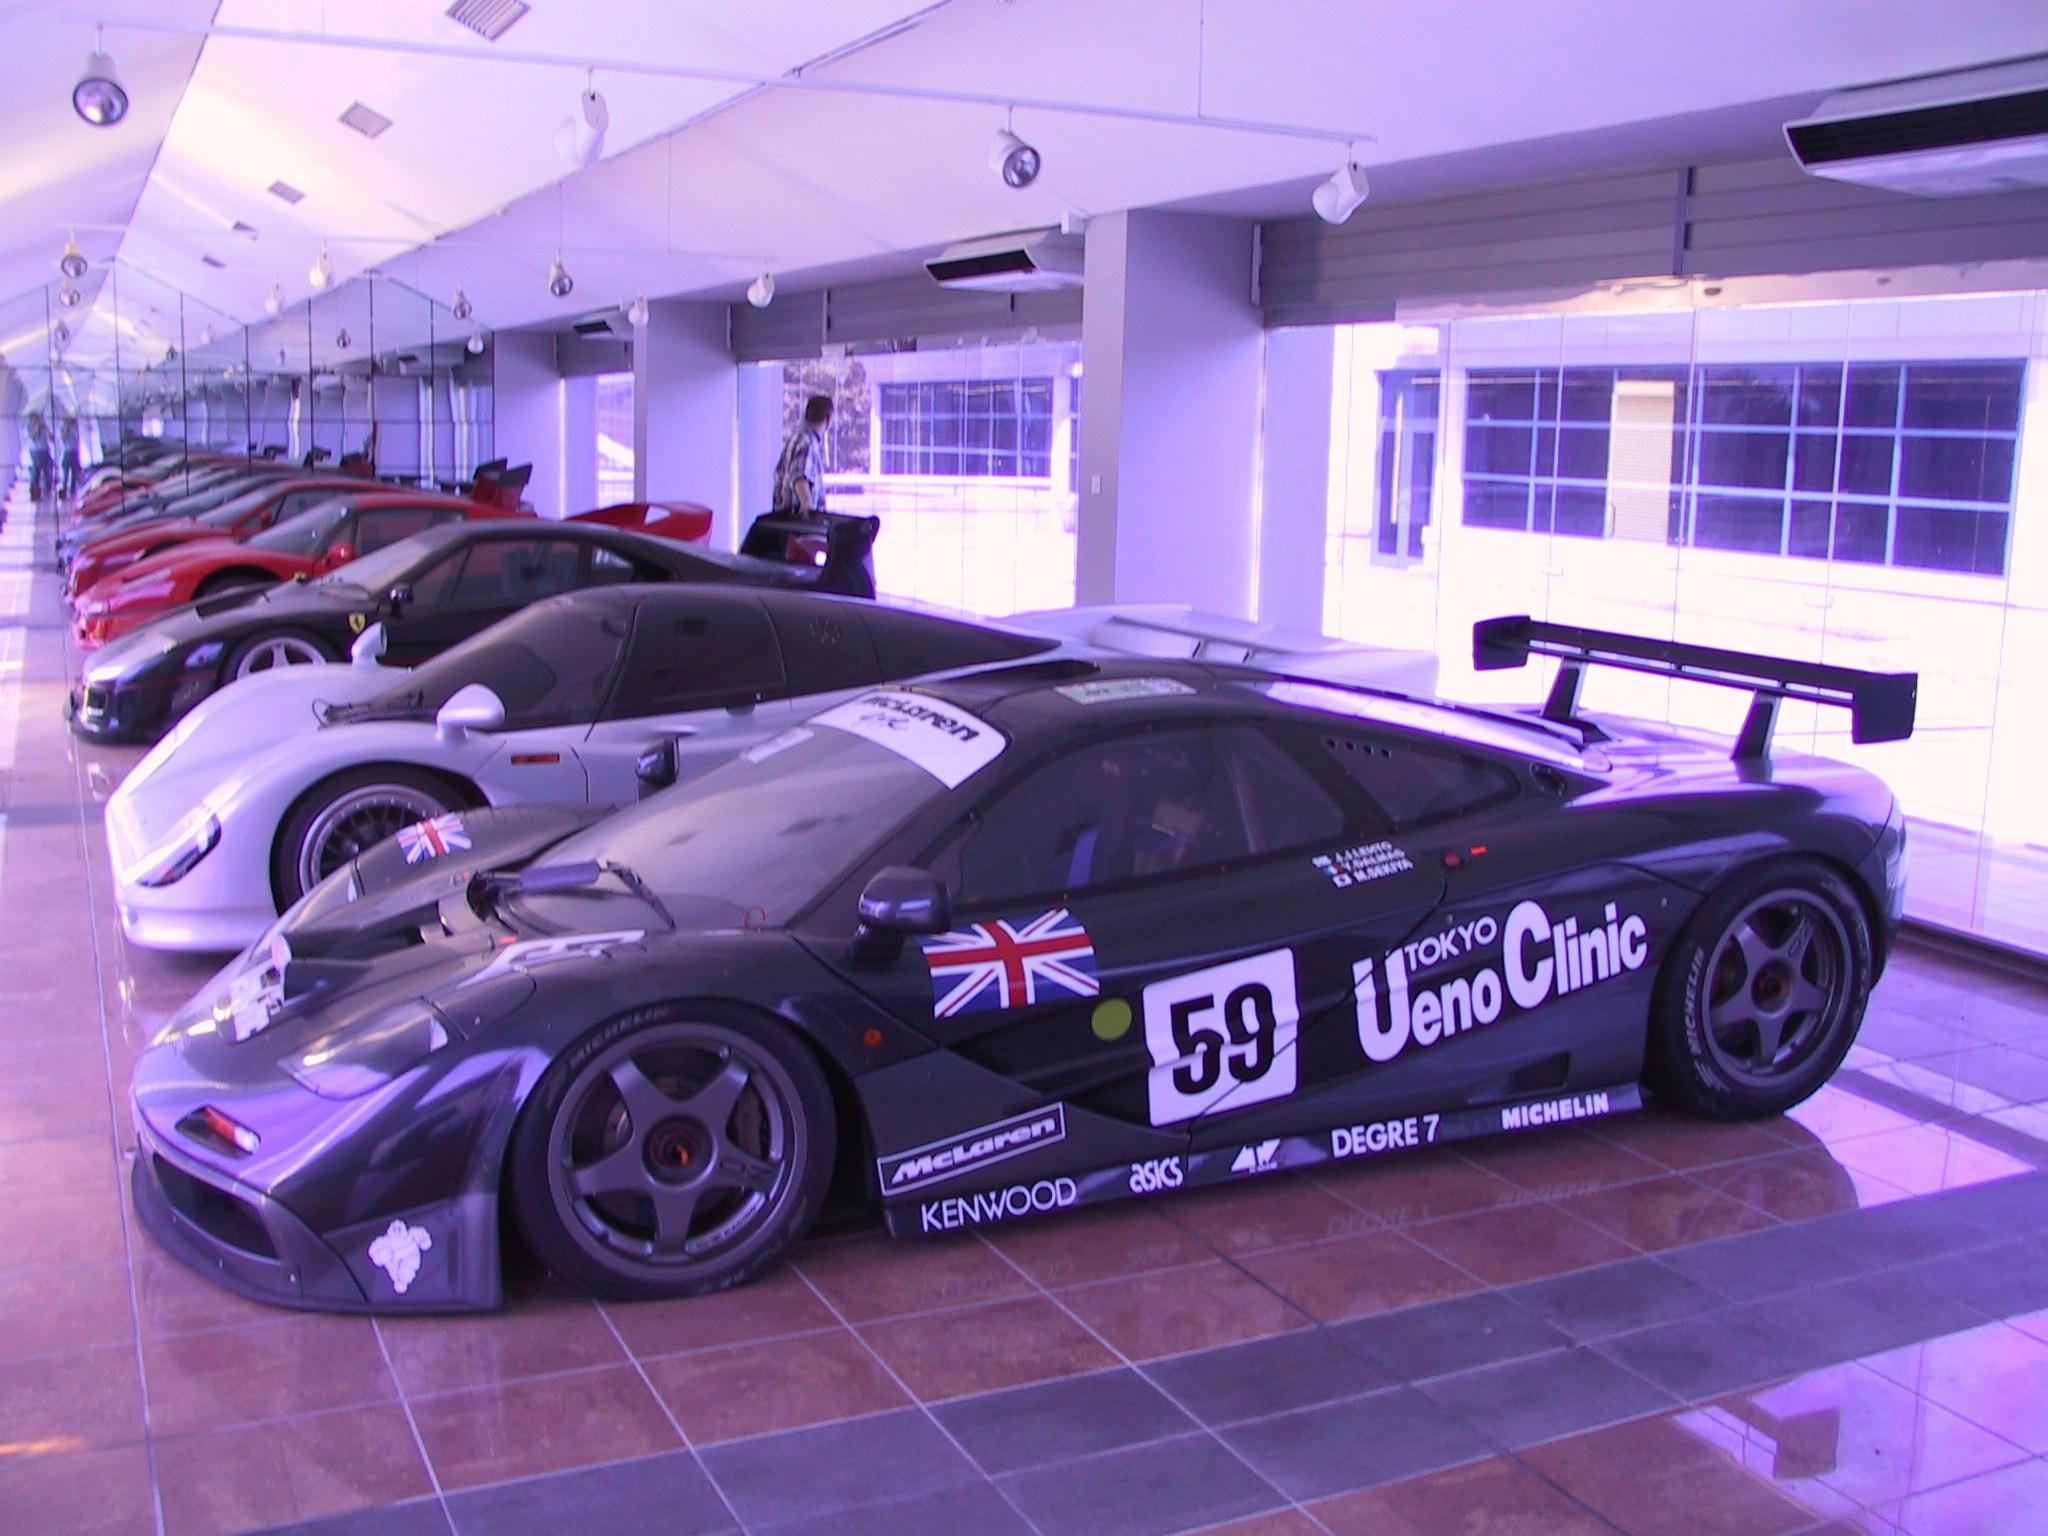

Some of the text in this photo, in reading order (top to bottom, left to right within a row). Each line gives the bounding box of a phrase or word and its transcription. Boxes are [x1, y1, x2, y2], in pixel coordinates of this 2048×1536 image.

[1404, 916, 1497, 972] TOKYO
[1352, 900, 1648, 1062] Ueno Clinic
[1170, 982, 1277, 1095] 59
[1331, 1113, 1441, 1160] DEGRE 7
[1501, 1092, 1609, 1131] MICHELIN
[891, 1116, 1057, 1186] McLaren
[920, 1177, 1079, 1233] KENWOOD
